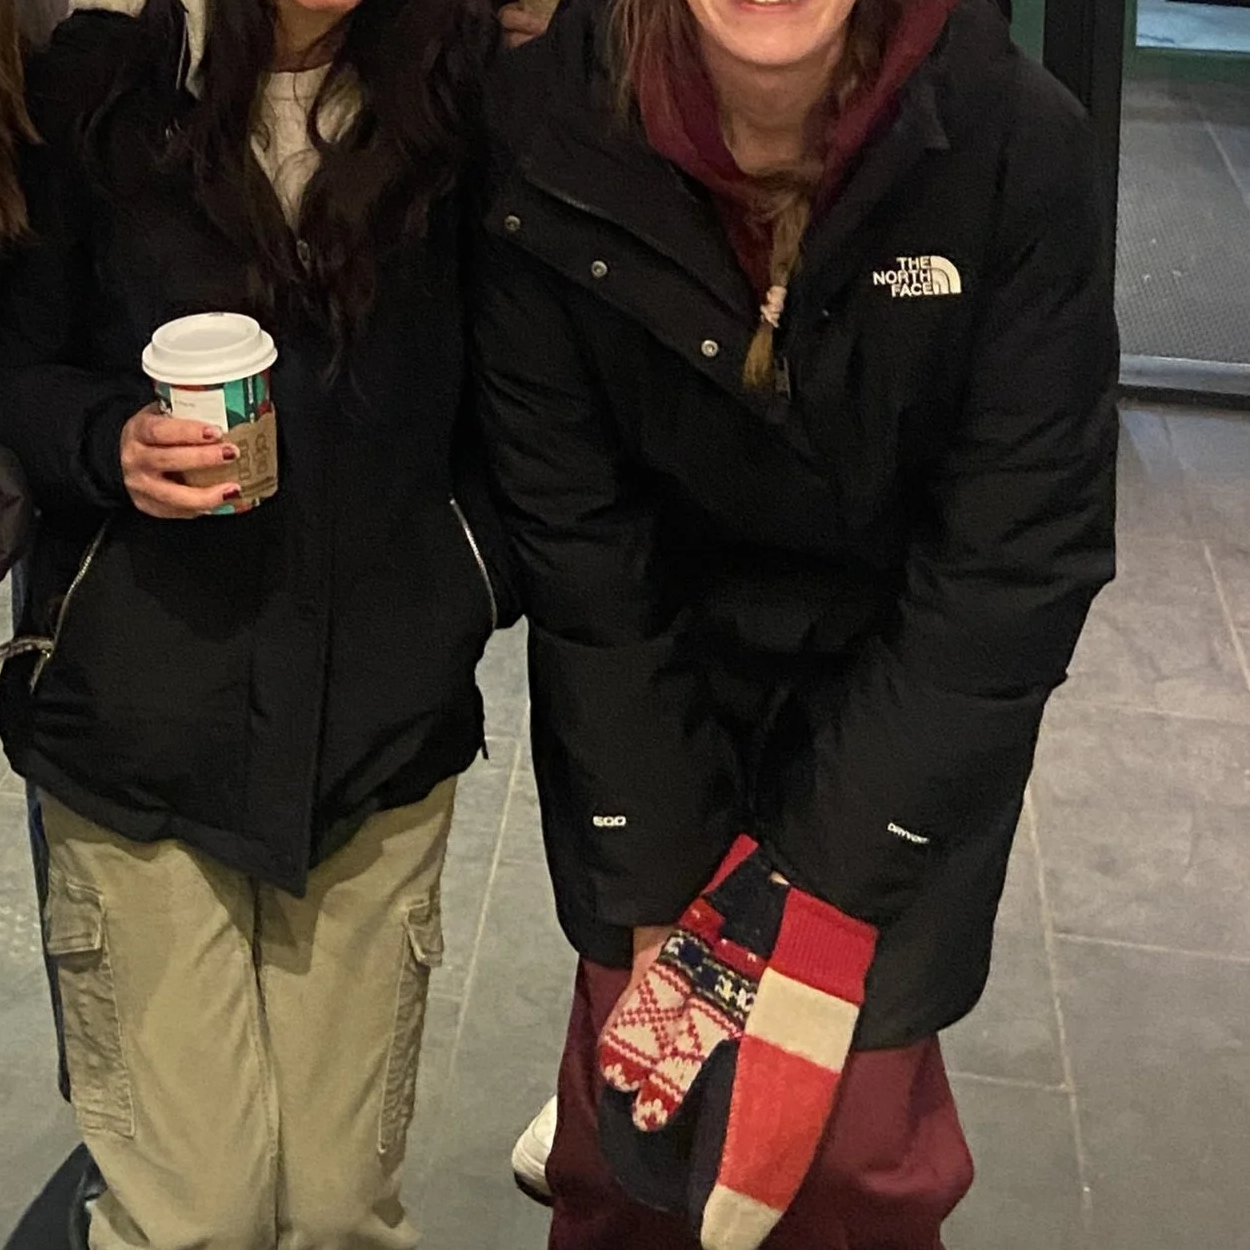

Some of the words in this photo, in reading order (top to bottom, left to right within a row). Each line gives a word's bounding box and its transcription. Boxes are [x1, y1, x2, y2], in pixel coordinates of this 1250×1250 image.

[896, 256, 931, 271] THE
[872, 269, 931, 285] NORTH
[891, 282, 933, 298] FACE
